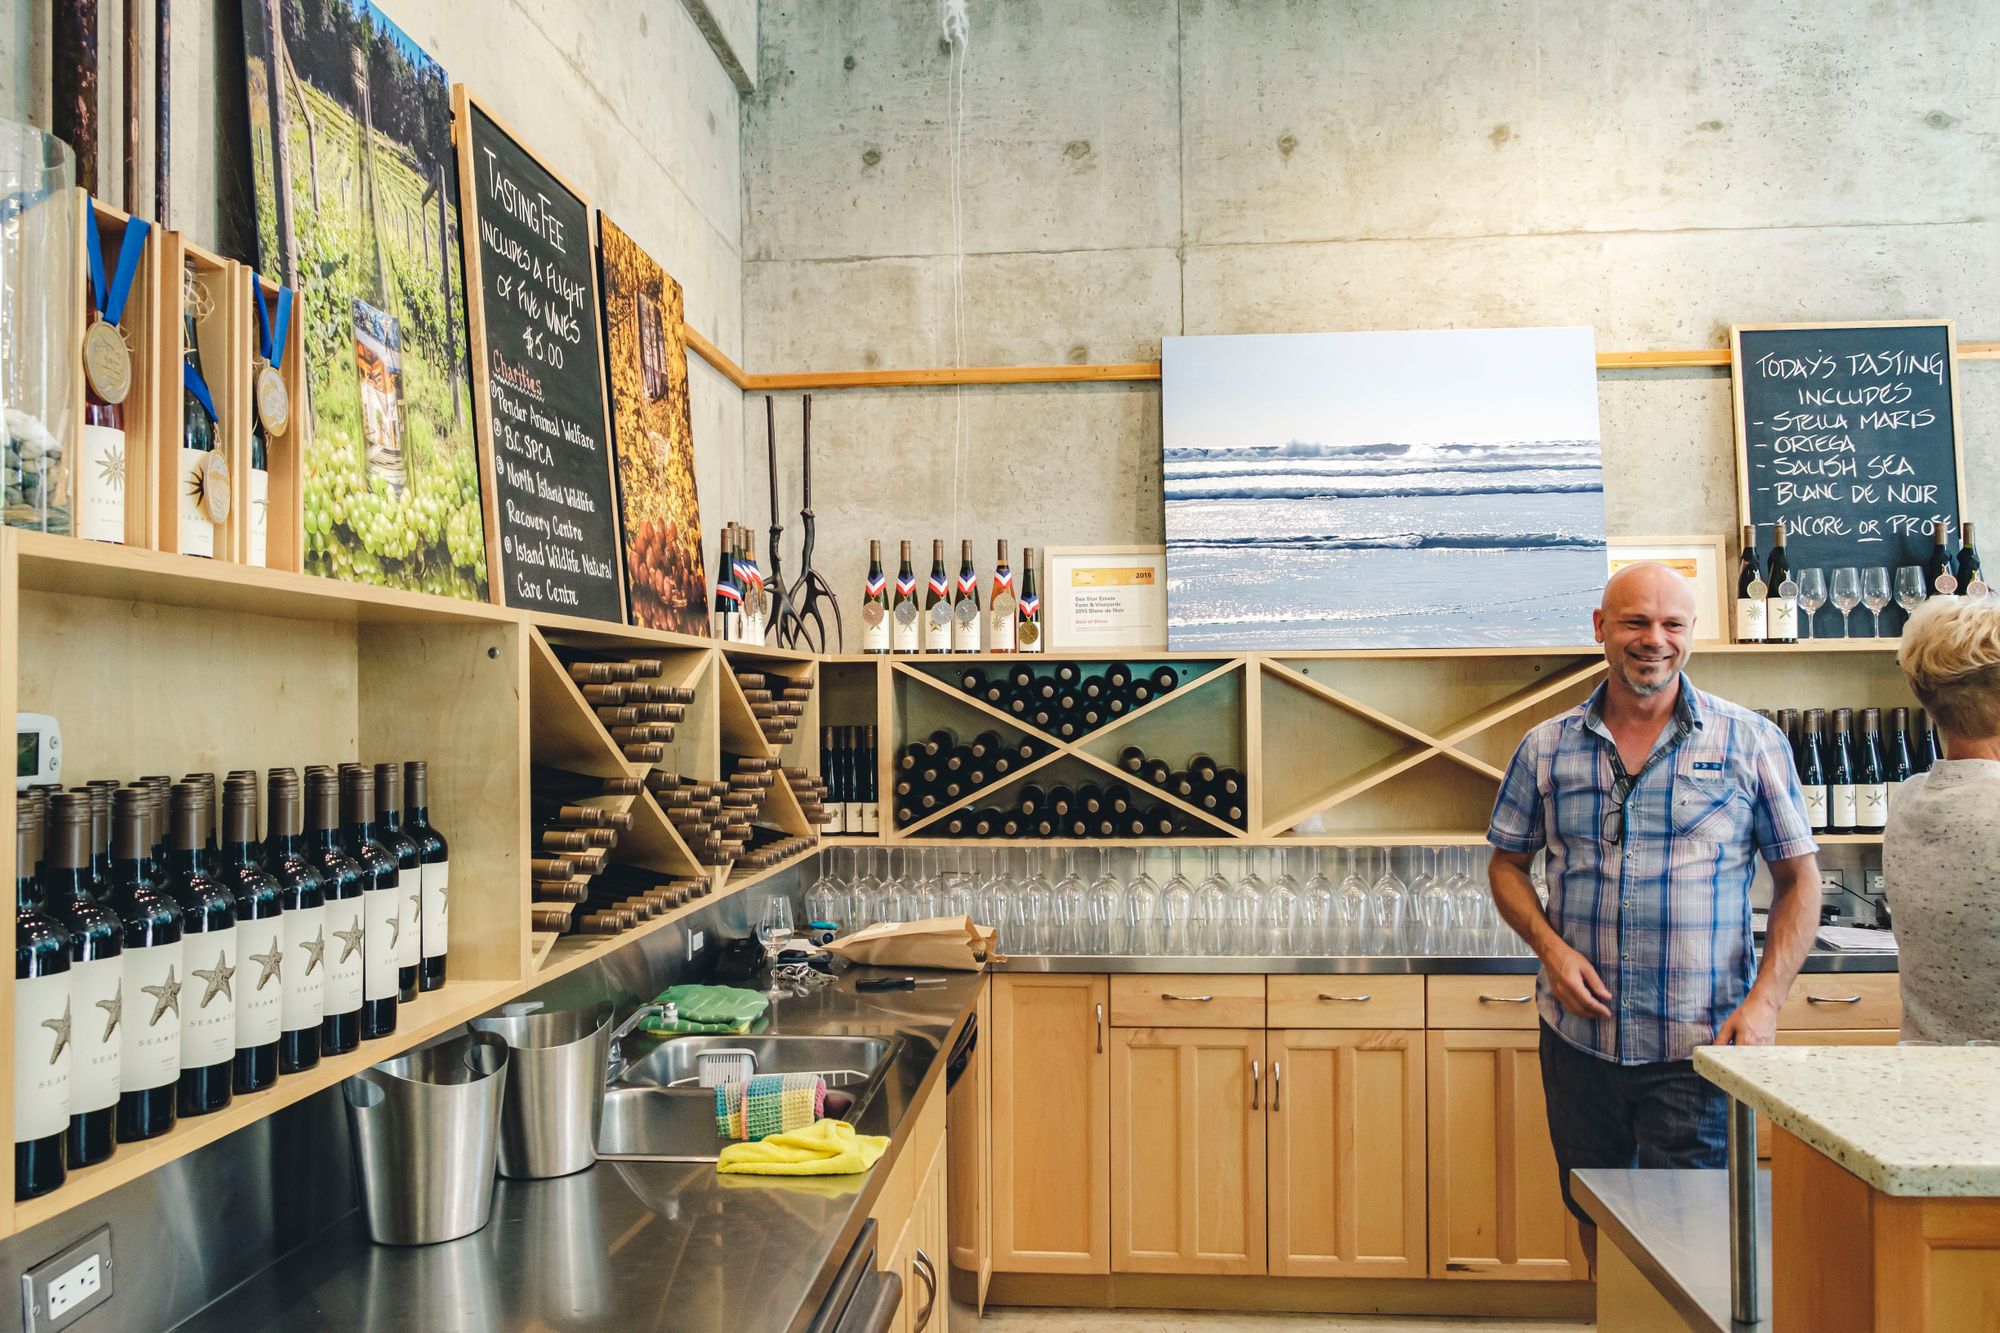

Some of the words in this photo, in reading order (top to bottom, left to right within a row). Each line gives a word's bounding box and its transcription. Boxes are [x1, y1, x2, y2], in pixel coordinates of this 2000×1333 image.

[483, 146, 539, 235] TASTING
[538, 192, 567, 255] FEE
[480, 216, 531, 271] INCLUDES
[533, 257, 543, 282] A
[546, 262, 586, 317] FLIGHT
[496, 274, 512, 301] OF
[517, 279, 541, 320] FIVE
[544, 300, 581, 344] WINES
[522, 323, 564, 370] $5.00
[1755, 348, 1837, 380] TODAY'S
[1845, 349, 1944, 386] TASTING
[493, 348, 542, 396] Charities
[1798, 382, 1912, 406] INCLUDES
[496, 386, 528, 423] Pender
[530, 404, 561, 438] Animal
[561, 418, 596, 451] Welfare
[1771, 410, 1848, 432] STELLA
[1860, 408, 1936, 430] MARIS
[524, 434, 555, 467] SPCA
[1773, 434, 1856, 453] ORTEGA
[1772, 454, 1857, 478] SALISH
[1867, 453, 1916, 479] SEA
[506, 462, 535, 494] North
[536, 471, 563, 505] Island
[563, 486, 595, 513] Wildlife
[1773, 481, 1844, 506] BLANC
[1850, 483, 1881, 505] DE
[1887, 483, 1939, 505] NOIR
[506, 498, 550, 540] Recovery
[552, 515, 584, 542] Centre
[1858, 519, 1881, 536] OR
[514, 534, 545, 567] Island
[545, 544, 581, 574] Wildlife
[581, 553, 612, 580] Natural
[517, 571, 543, 600] Care
[546, 578, 579, 606] Centre
